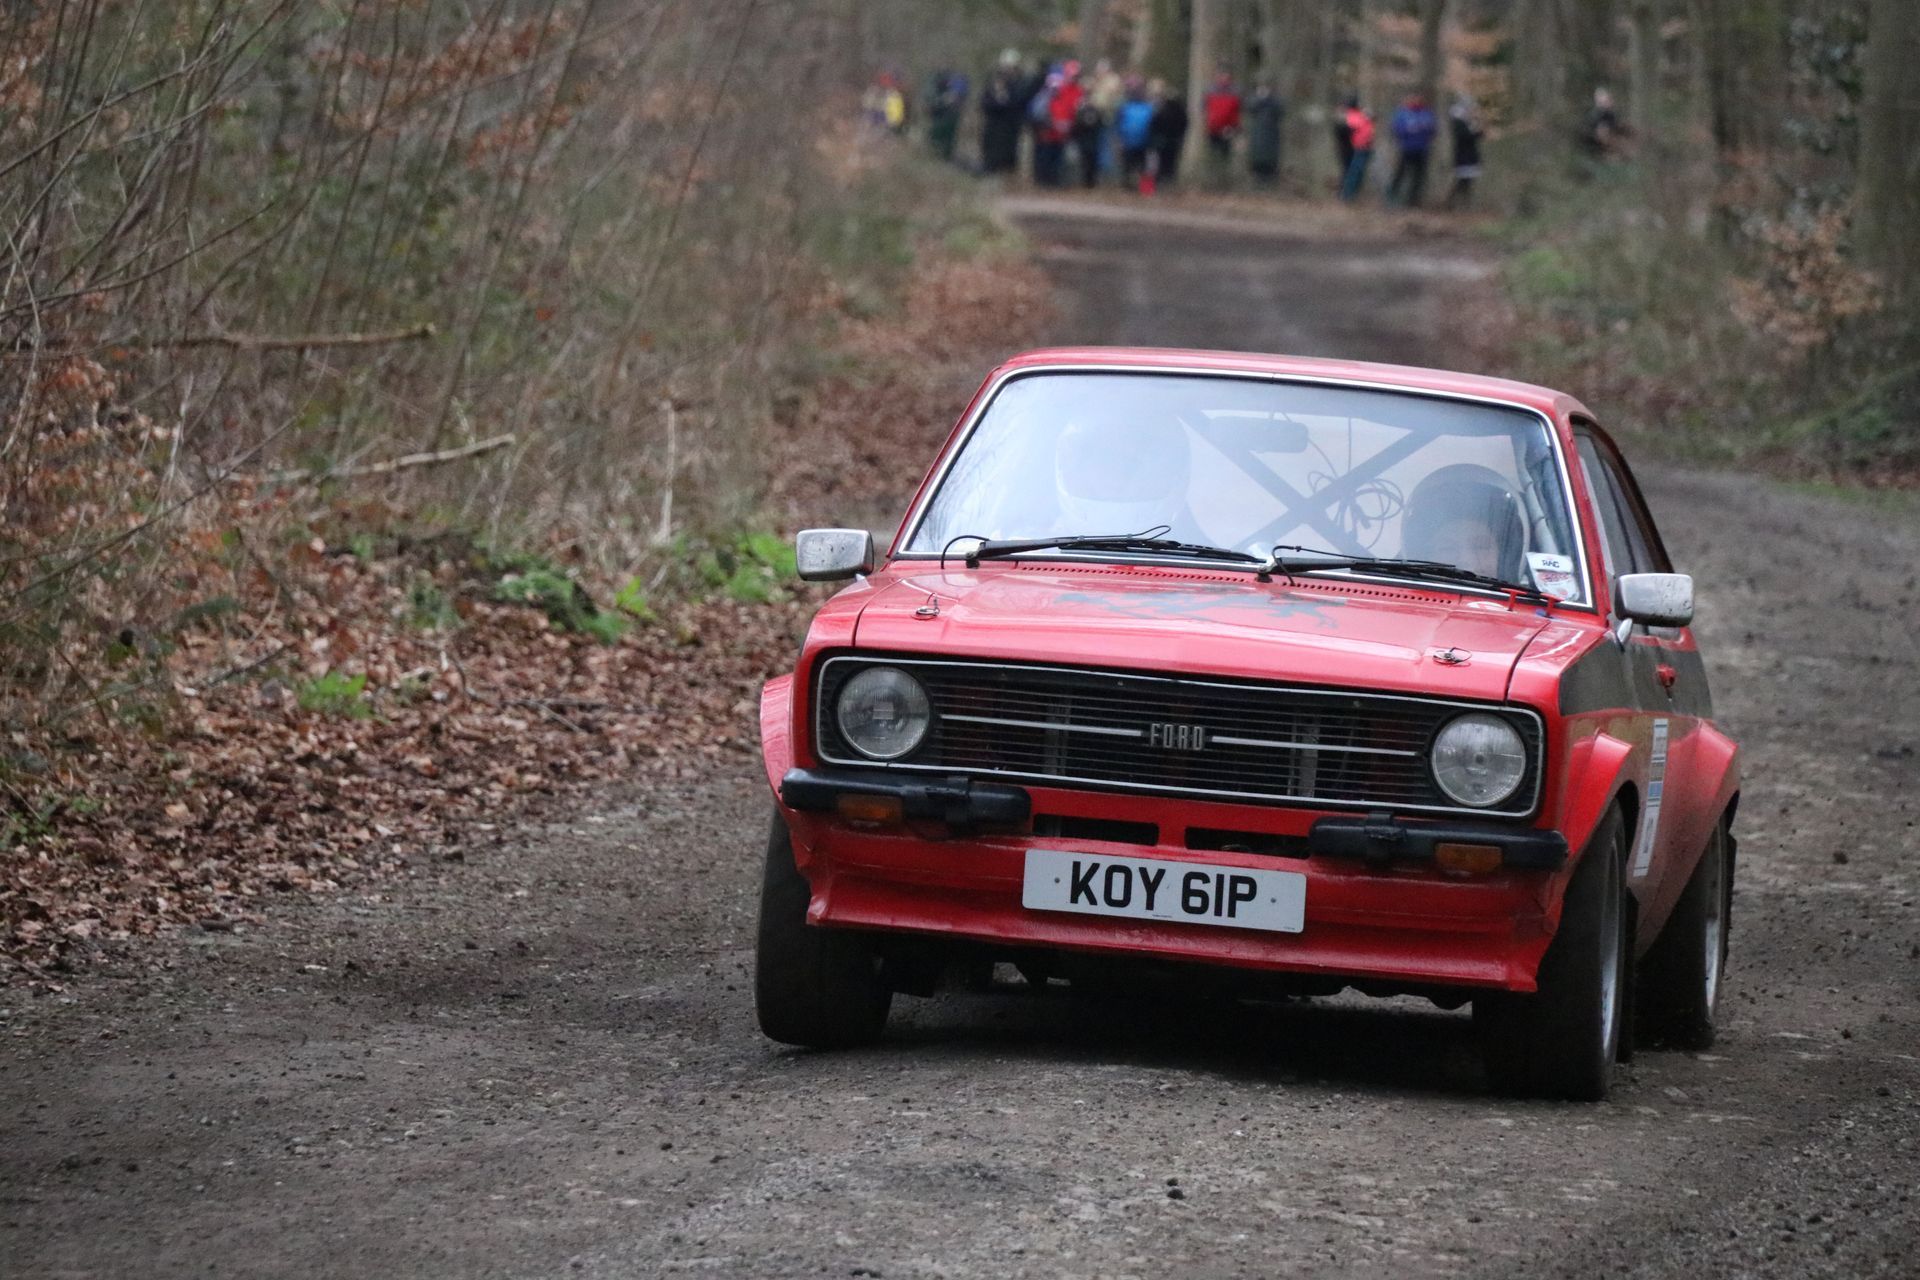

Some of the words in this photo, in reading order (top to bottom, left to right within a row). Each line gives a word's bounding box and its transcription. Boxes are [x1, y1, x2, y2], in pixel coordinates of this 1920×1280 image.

[1150, 723, 1203, 751] FORD
[1069, 860, 1166, 911] KOY
[1181, 871, 1258, 918] 61P
